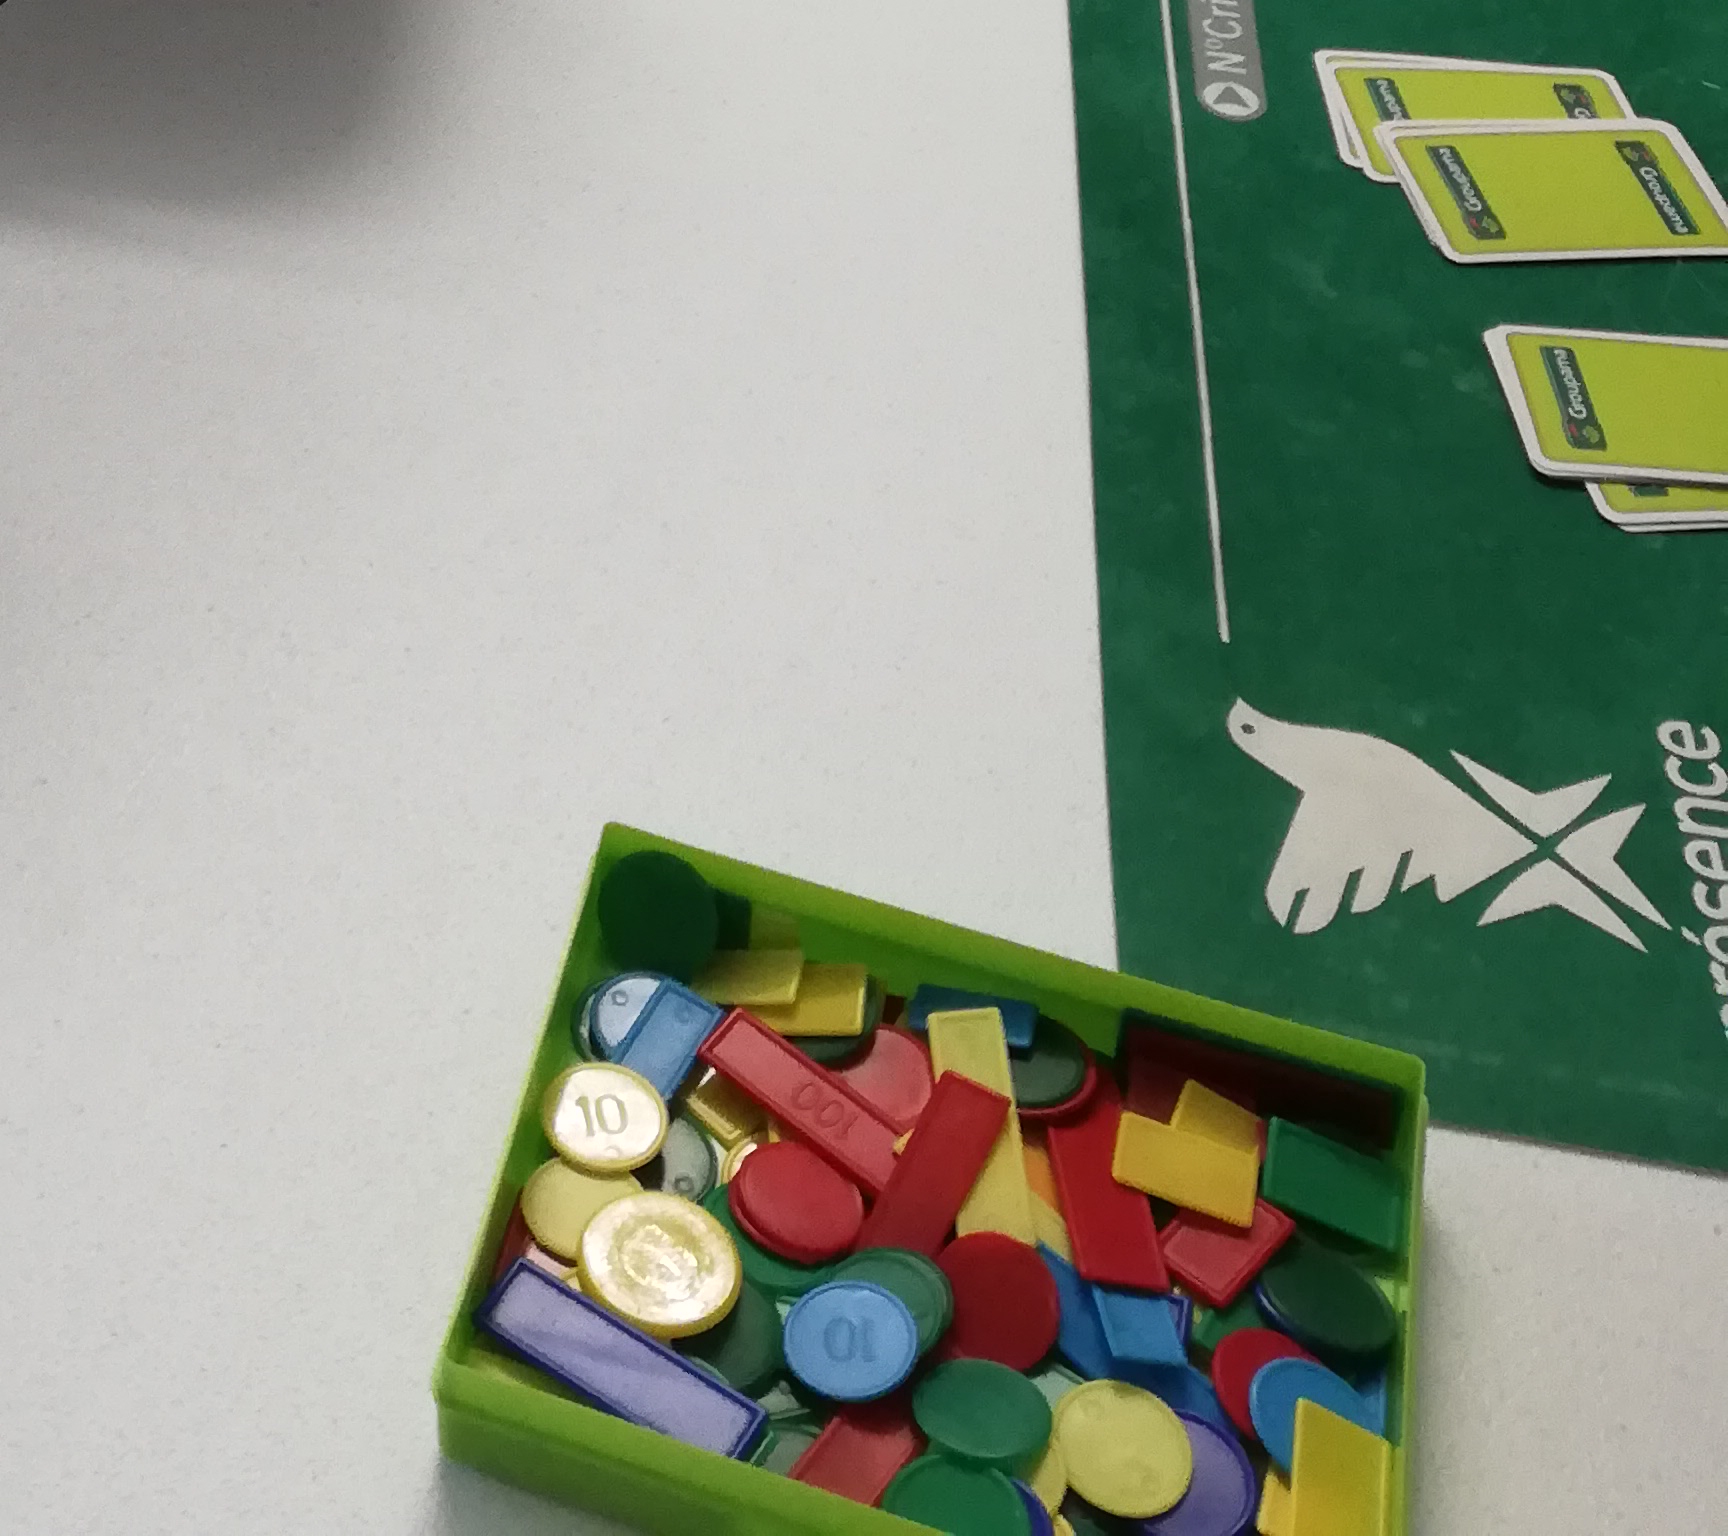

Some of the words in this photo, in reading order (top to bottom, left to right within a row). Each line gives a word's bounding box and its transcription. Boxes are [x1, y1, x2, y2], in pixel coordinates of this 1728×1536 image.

[1638, 166, 1690, 235] Groupama
[1553, 348, 1589, 420] Groupama
[574, 1091, 629, 1137] 10
